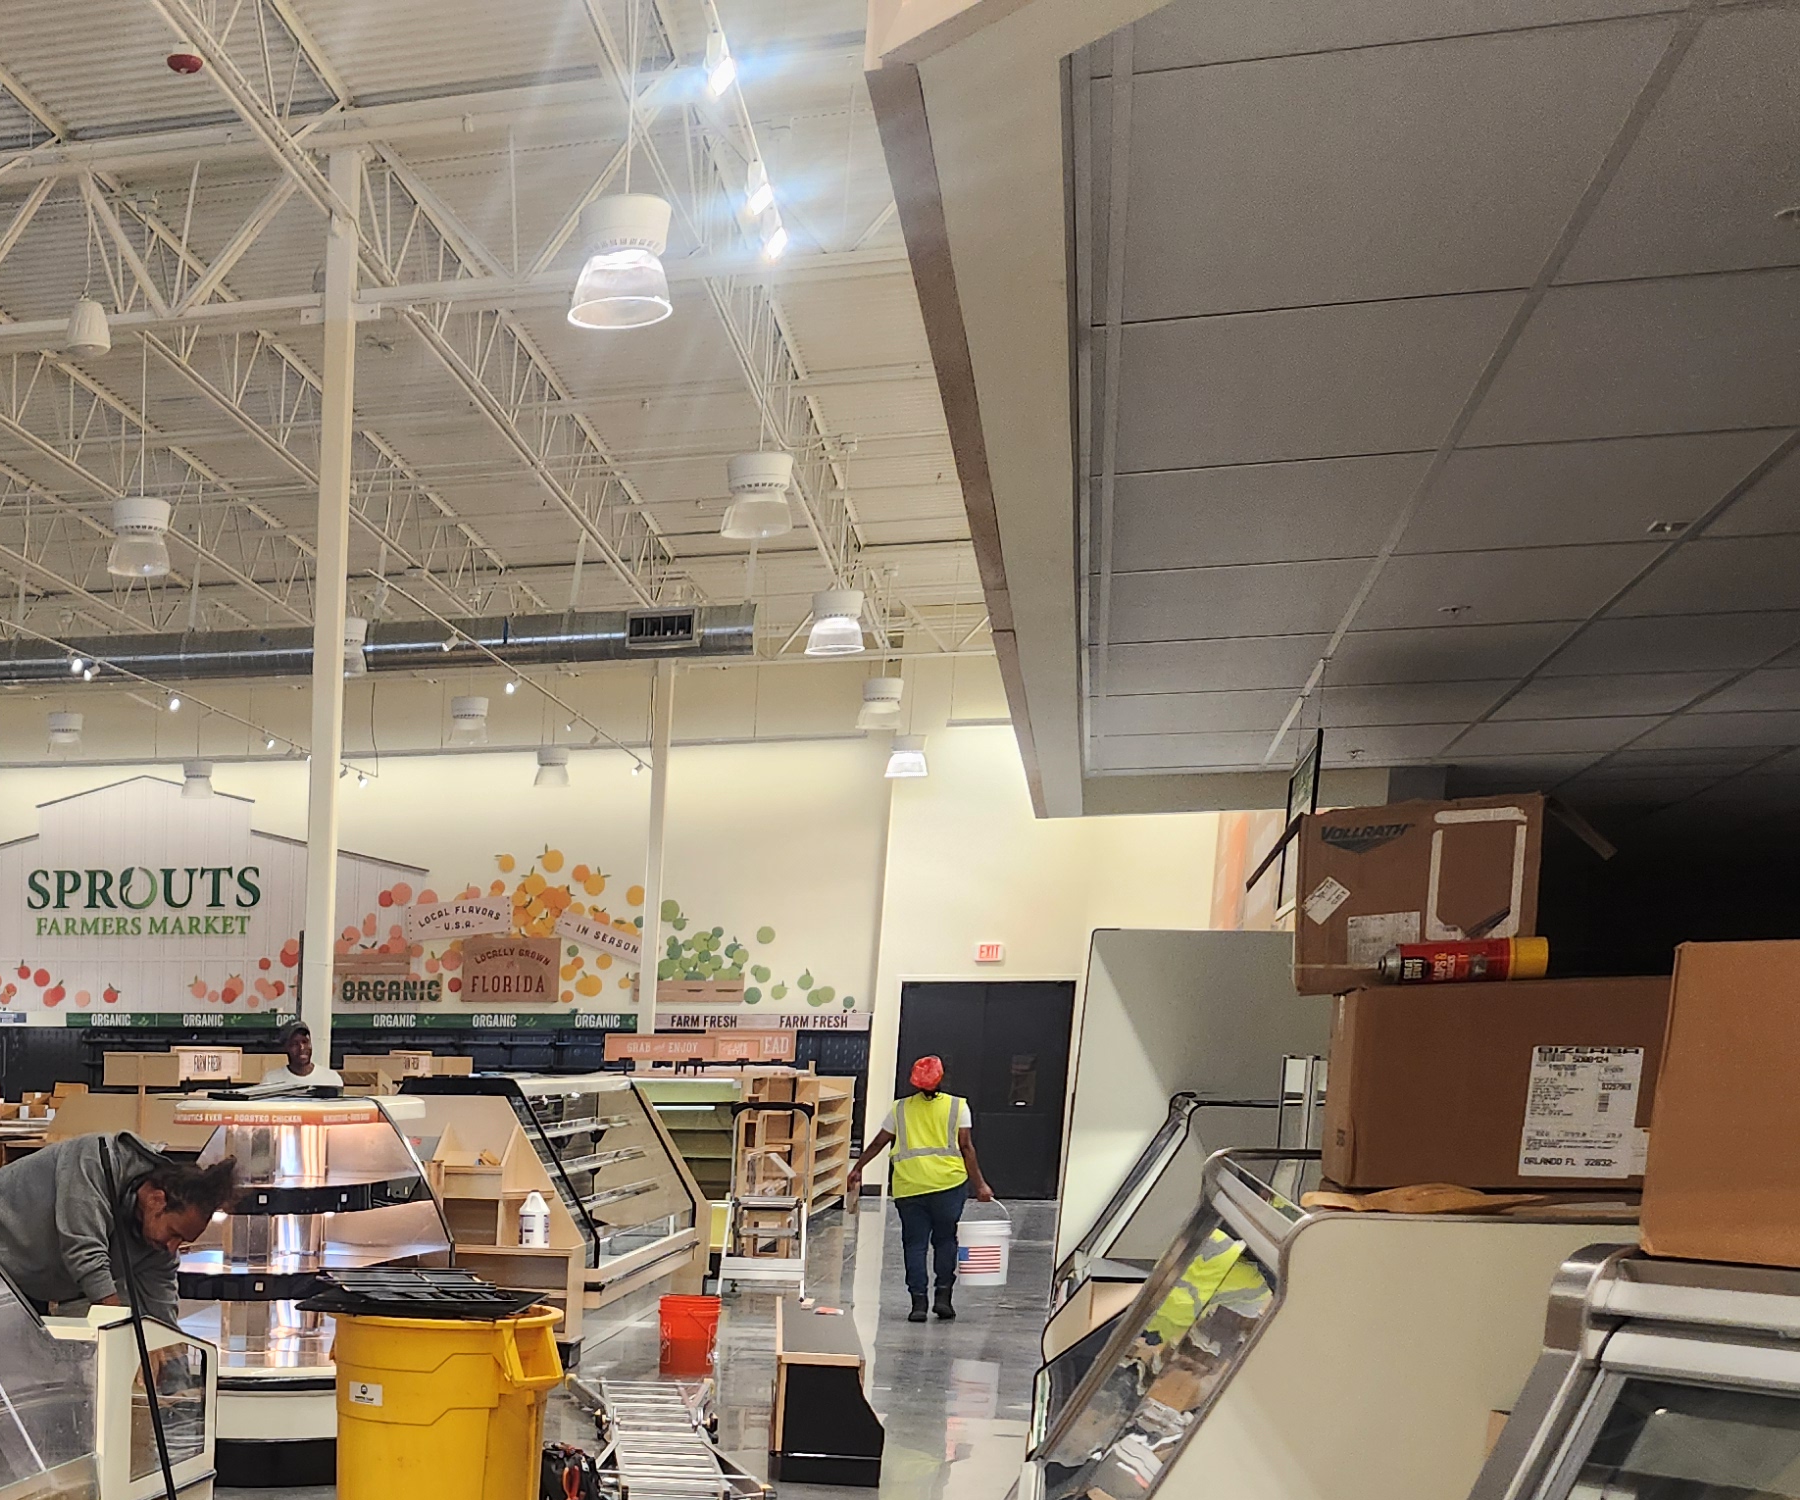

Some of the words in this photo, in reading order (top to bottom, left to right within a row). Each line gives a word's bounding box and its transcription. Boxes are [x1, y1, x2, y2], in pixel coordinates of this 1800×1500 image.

[1321, 824, 1409, 841] VOLLRATH
[27, 866, 261, 910] SPROUTS
[418, 907, 450, 928] LOCAL
[454, 905, 501, 922] FLAVORS
[35, 916, 142, 937] FARMERS
[148, 915, 251, 936] MARKET
[575, 924, 589, 936] IN
[593, 930, 640, 954] SEASON
[474, 947, 515, 966] LOCALLY
[518, 948, 552, 967] GROWN
[979, 944, 999, 959] EXIT
[341, 979, 441, 1002] ORGANIC
[471, 975, 546, 994] FLORIDA
[91, 1013, 131, 1026] ORGANIC
[183, 1014, 224, 1027] ORGANIC
[373, 1014, 416, 1028] ORGANIC
[472, 1014, 517, 1028] ORGANIC
[574, 1014, 621, 1028] ORGANIC
[670, 1015, 700, 1027] FARM
[703, 1015, 738, 1028] FRESH
[779, 1015, 809, 1028] FARM
[812, 1015, 849, 1029] FRESH
[626, 1041, 651, 1053] GRAB
[668, 1040, 698, 1054] ENJOY
[763, 1036, 790, 1055] EAD
[233, 1113, 270, 1124] ROASTED
[271, 1114, 302, 1124] CHICKEN
[1523, 1156, 1563, 1166] ORLANDO
[1565, 1157, 1577, 1167] FL
